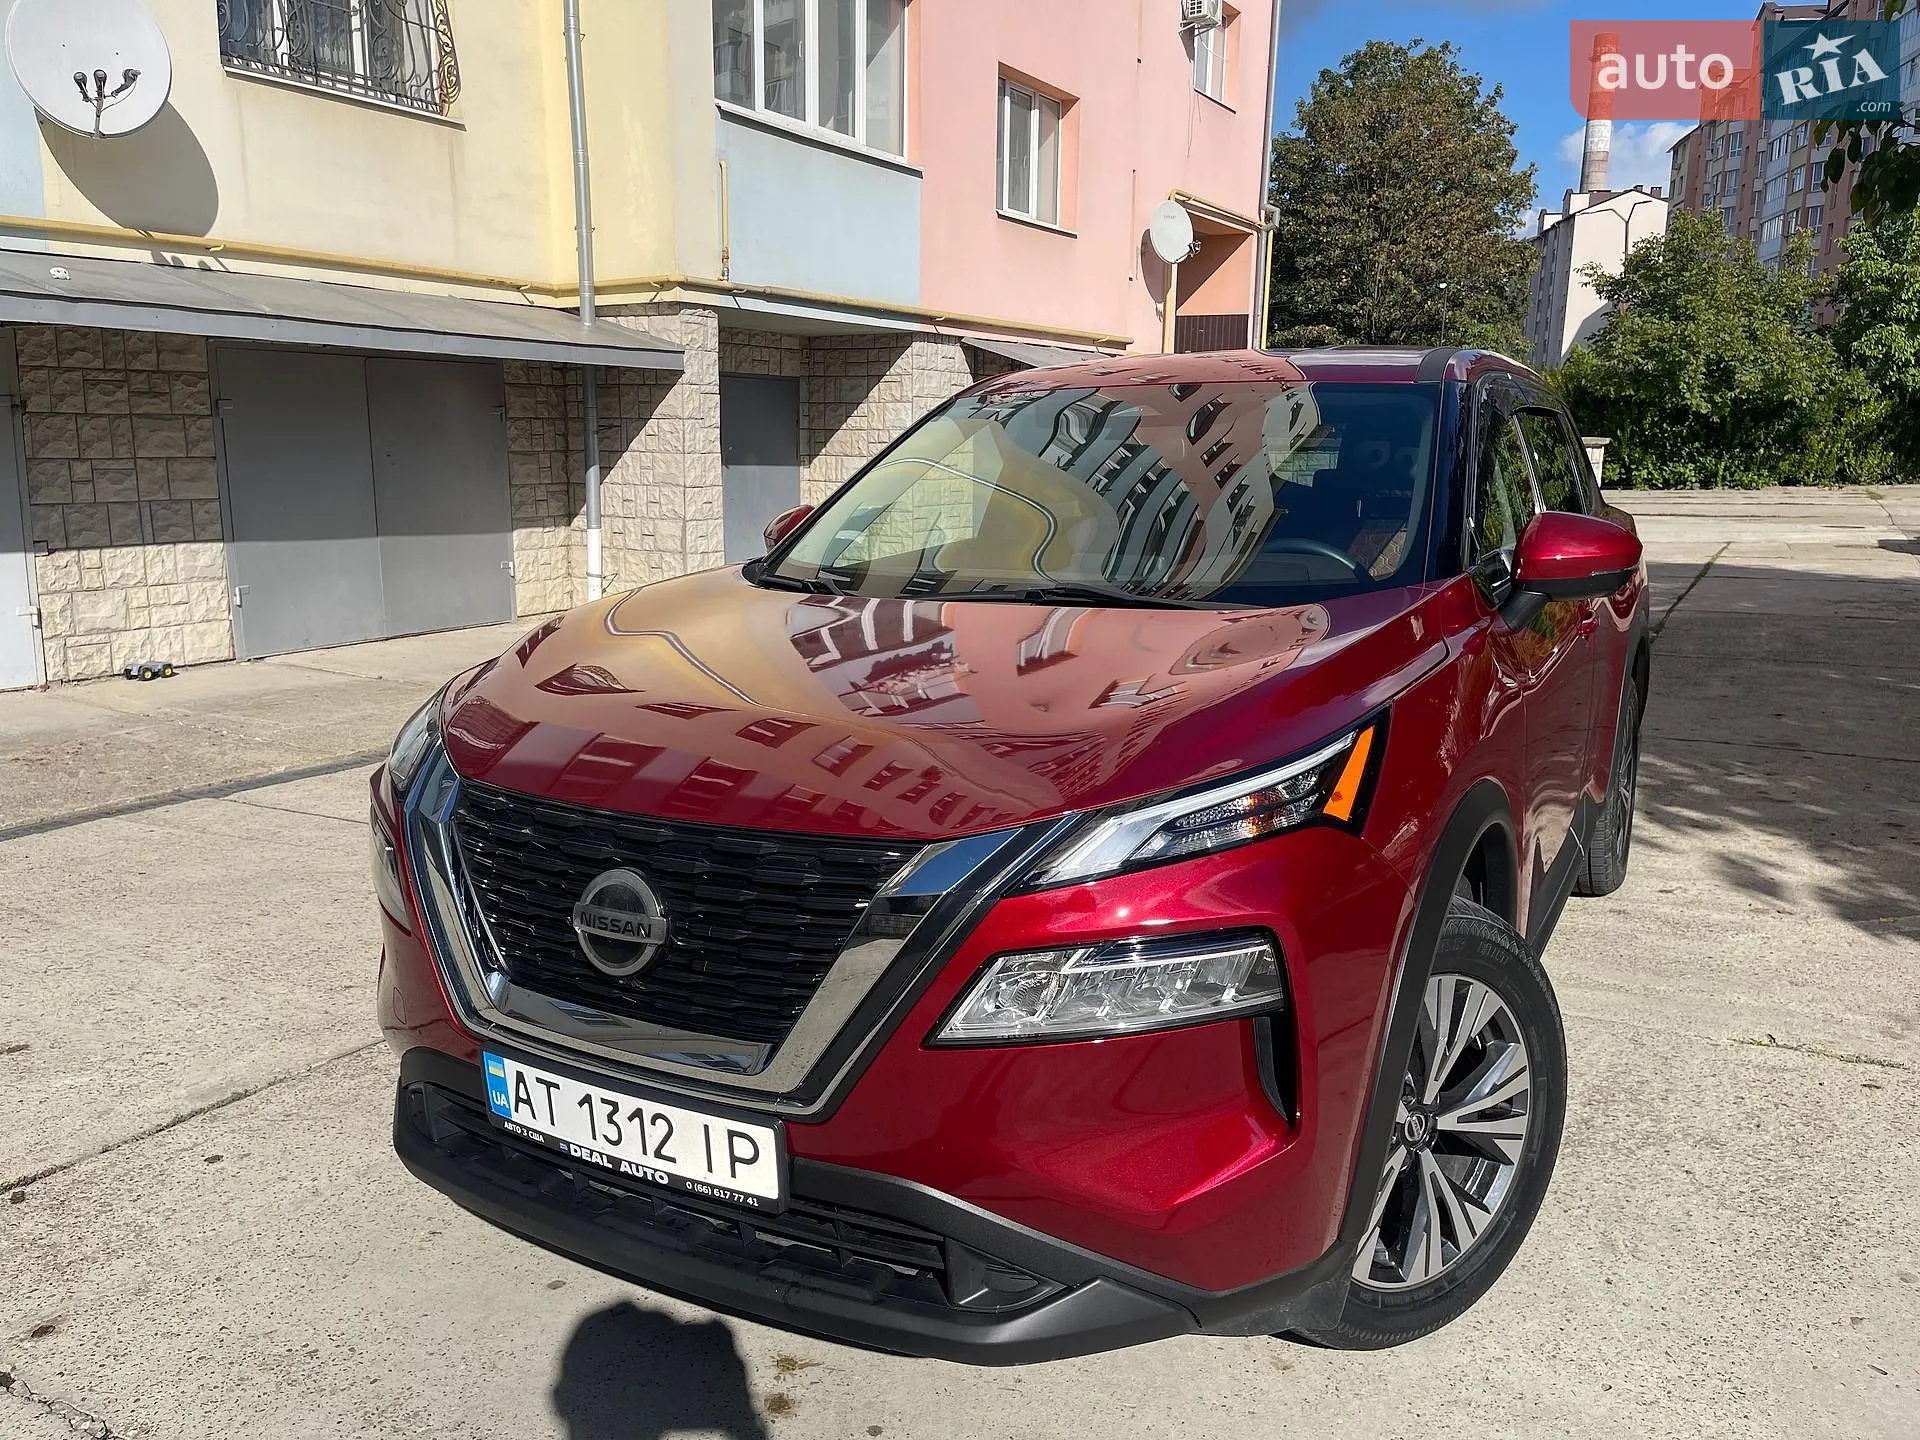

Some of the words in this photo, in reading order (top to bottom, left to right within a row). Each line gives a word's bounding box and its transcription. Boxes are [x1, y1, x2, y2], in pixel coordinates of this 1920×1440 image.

[580, 910, 652, 938] NISSAN
[492, 1089, 509, 1109] UA
[504, 1121, 521, 1134] АВТО
[528, 1131, 545, 1143] США
[514, 1070, 560, 1127] AT
[577, 1093, 677, 1164] 1312
[703, 1124, 760, 1179] IP
[569, 1143, 613, 1168] DEAL
[620, 1161, 669, 1184] AUTO
[694, 1183, 712, 1196] (66)
[713, 1188, 731, 1200] 617
[732, 1192, 745, 1203] 77
[746, 1196, 759, 1207] 41
